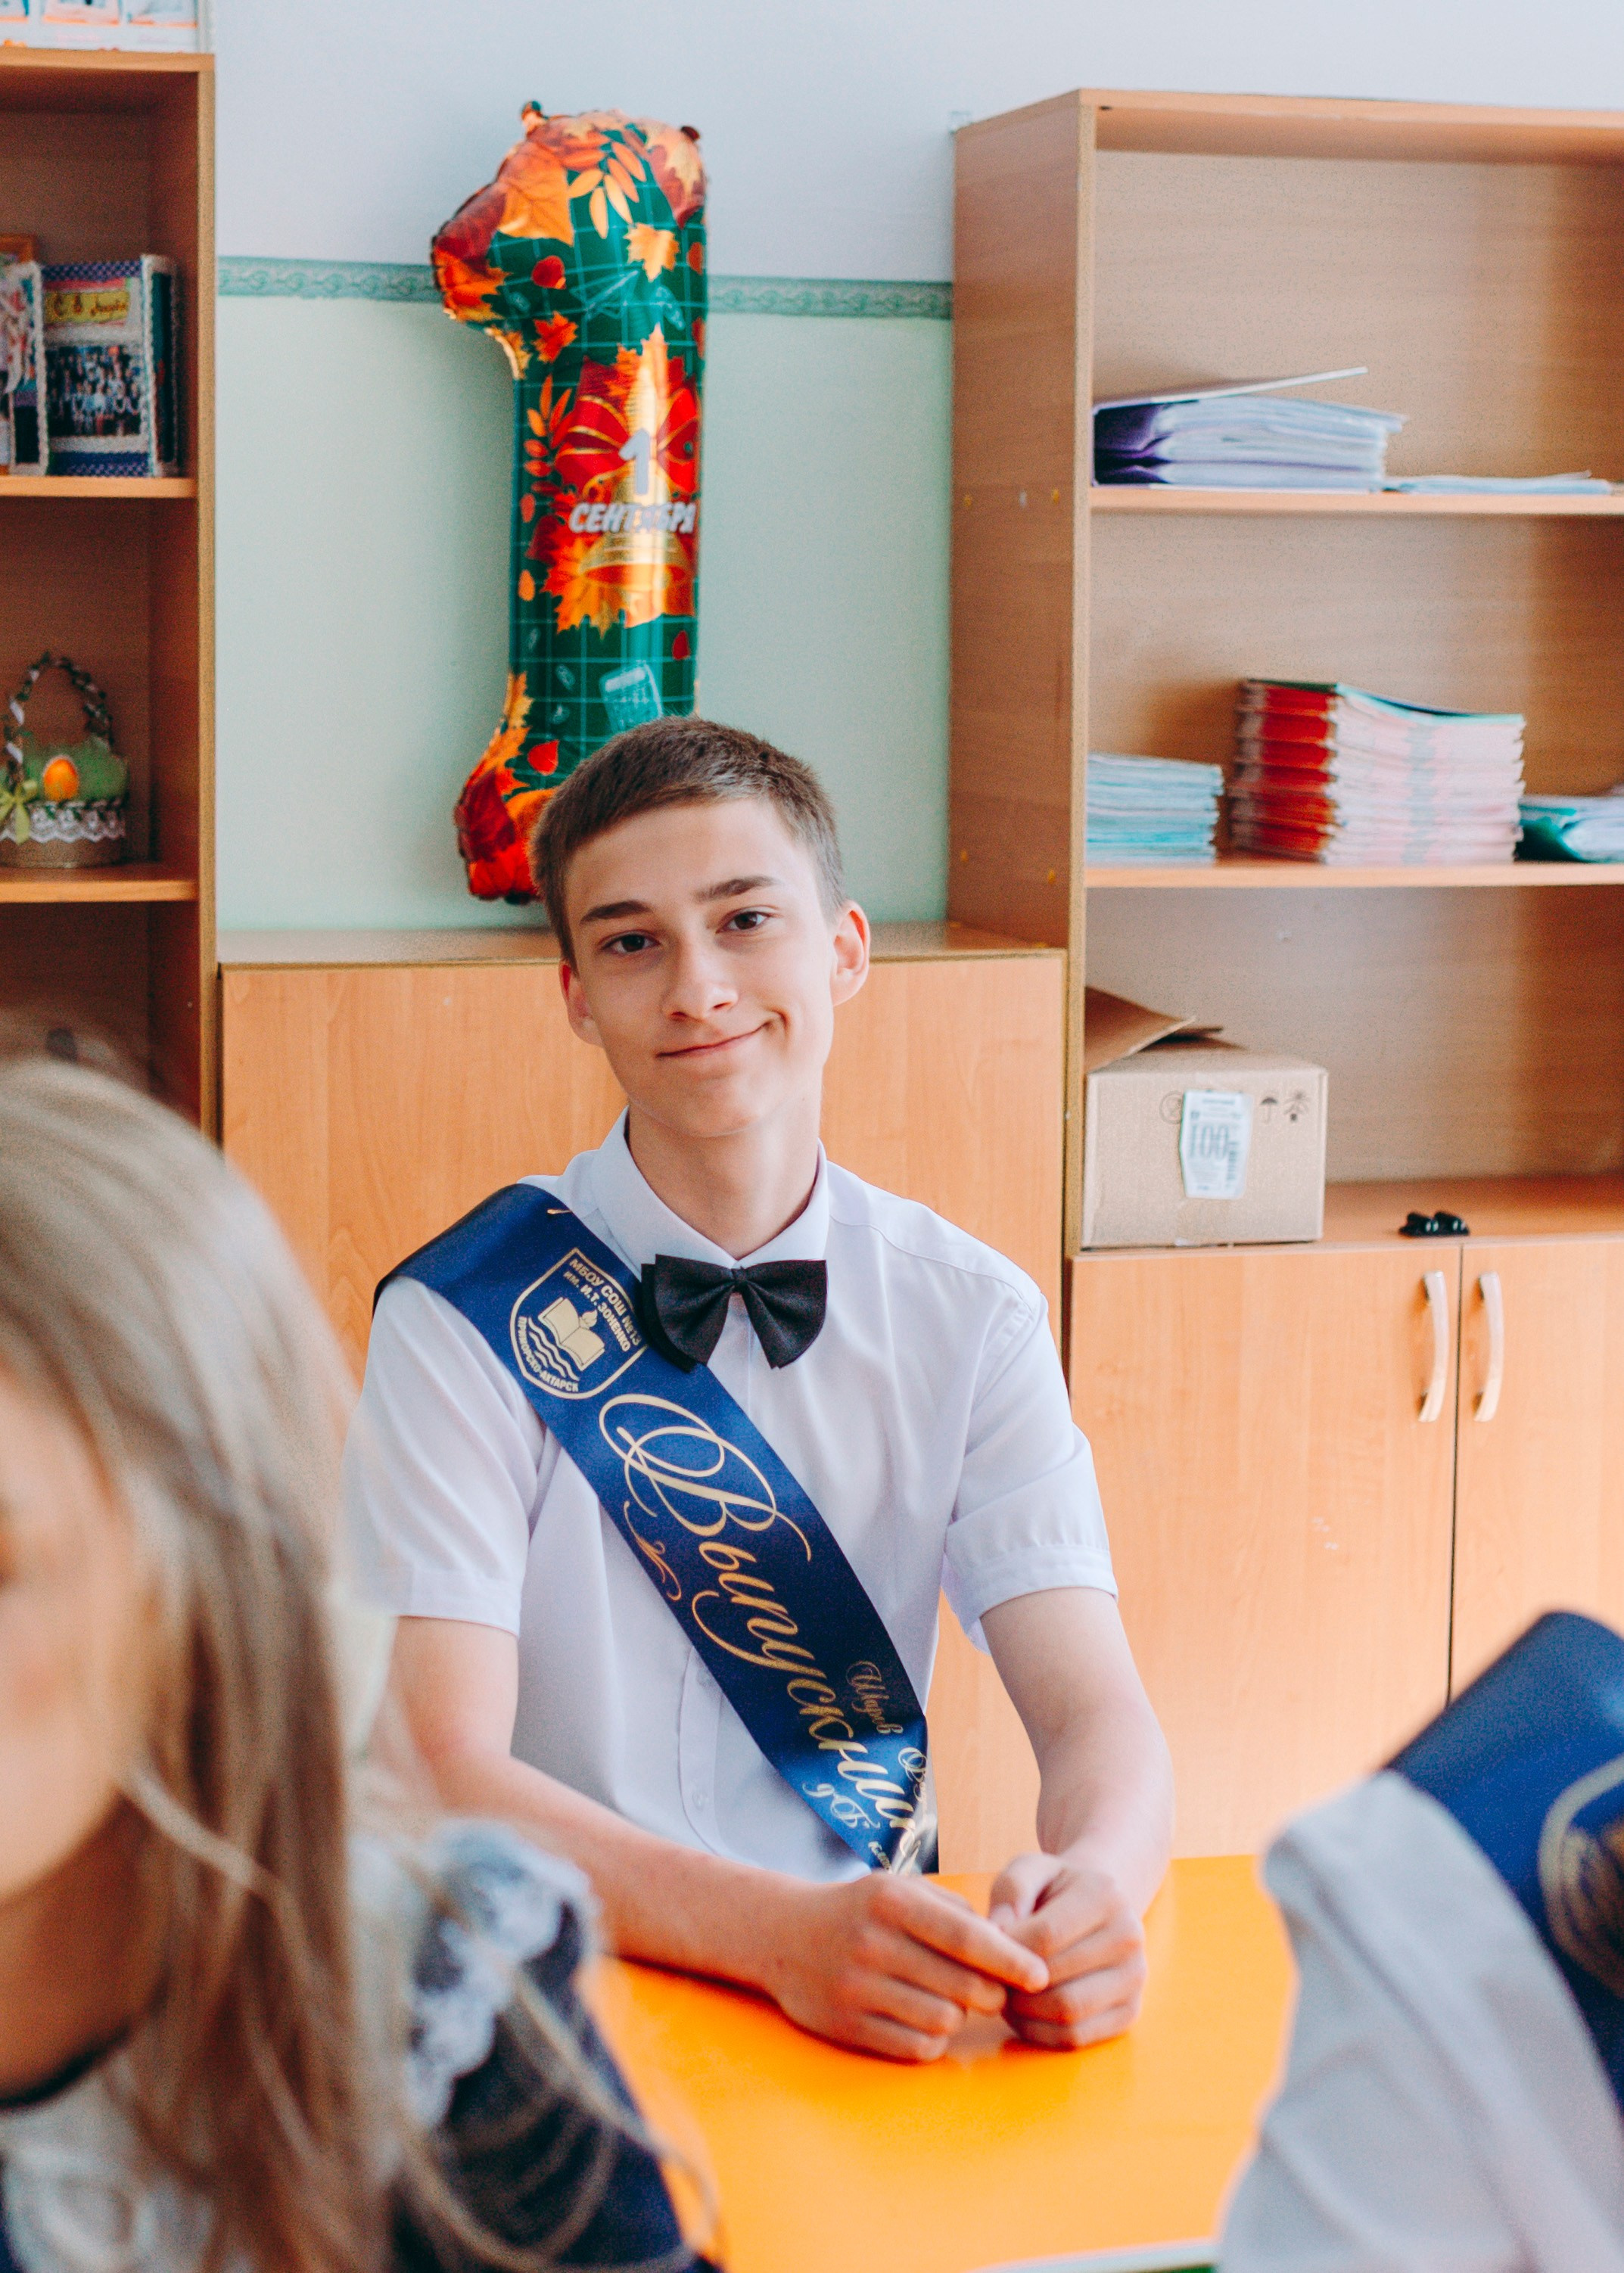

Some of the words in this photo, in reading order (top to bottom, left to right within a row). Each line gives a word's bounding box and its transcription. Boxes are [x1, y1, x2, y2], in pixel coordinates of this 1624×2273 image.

[618, 428, 651, 496] 1
[563, 1271, 580, 1288] им.
[598, 1302, 630, 1351] ЗОНЕНКО
[569, 1258, 604, 1286] МБОУ
[601, 1286, 627, 1316] СОШ
[518, 1316, 579, 1392] ПРИМОРСКО-АХТАРСК
